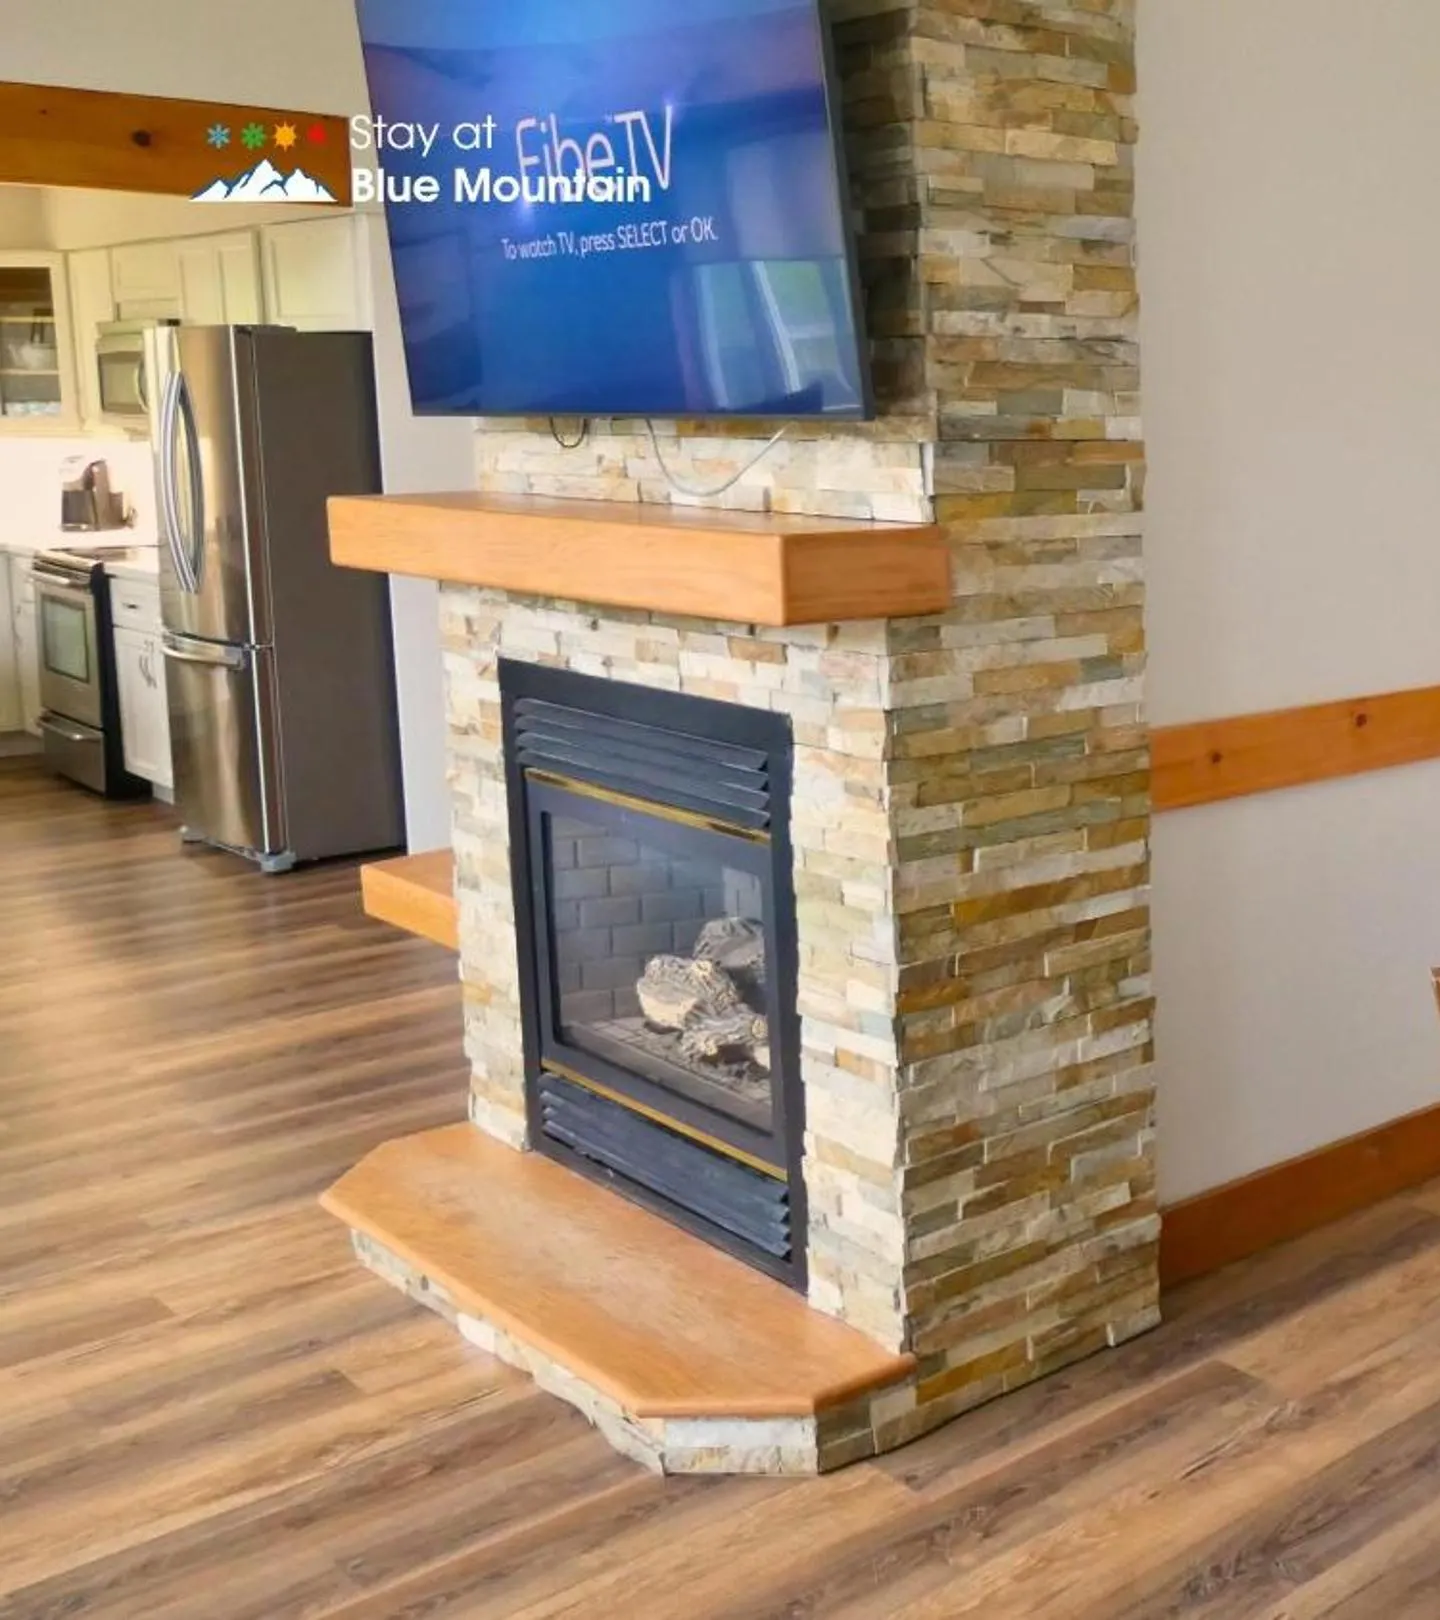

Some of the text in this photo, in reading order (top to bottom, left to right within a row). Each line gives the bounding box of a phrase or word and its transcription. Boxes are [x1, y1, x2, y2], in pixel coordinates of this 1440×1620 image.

[501, 237, 517, 260] To
[518, 234, 557, 259] watch
[556, 231, 580, 256] TV,
[579, 232, 616, 258] press
[617, 220, 668, 249] SELECT
[671, 224, 689, 244] or
